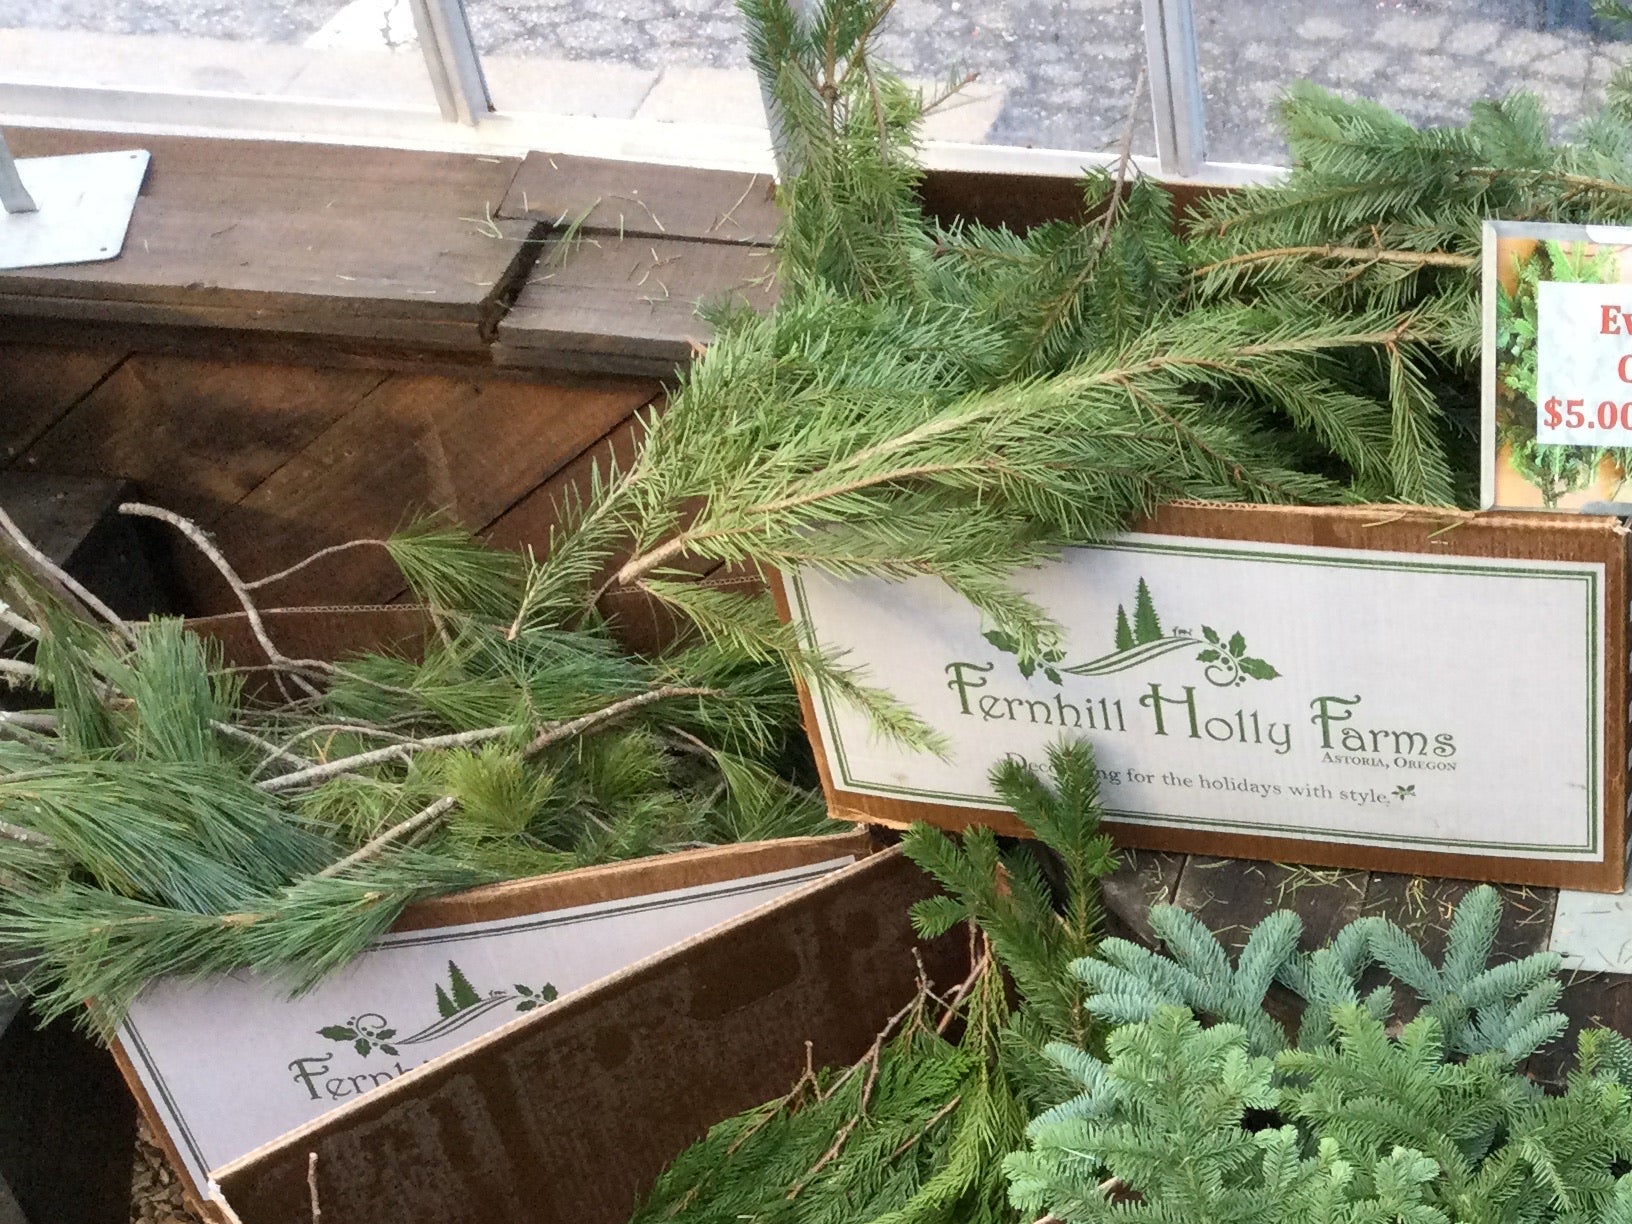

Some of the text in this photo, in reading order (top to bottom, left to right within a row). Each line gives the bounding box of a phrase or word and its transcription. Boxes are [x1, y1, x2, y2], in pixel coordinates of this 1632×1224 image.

[945, 661, 1457, 757] Fernhill Holly Farms
[1127, 767, 1155, 784] for
[1163, 771, 1193, 788] the
[1199, 774, 1282, 797] holidays
[1288, 783, 1332, 800] with
[1394, 756, 1457, 771] OREGON
[288, 1052, 414, 1100] Fern
